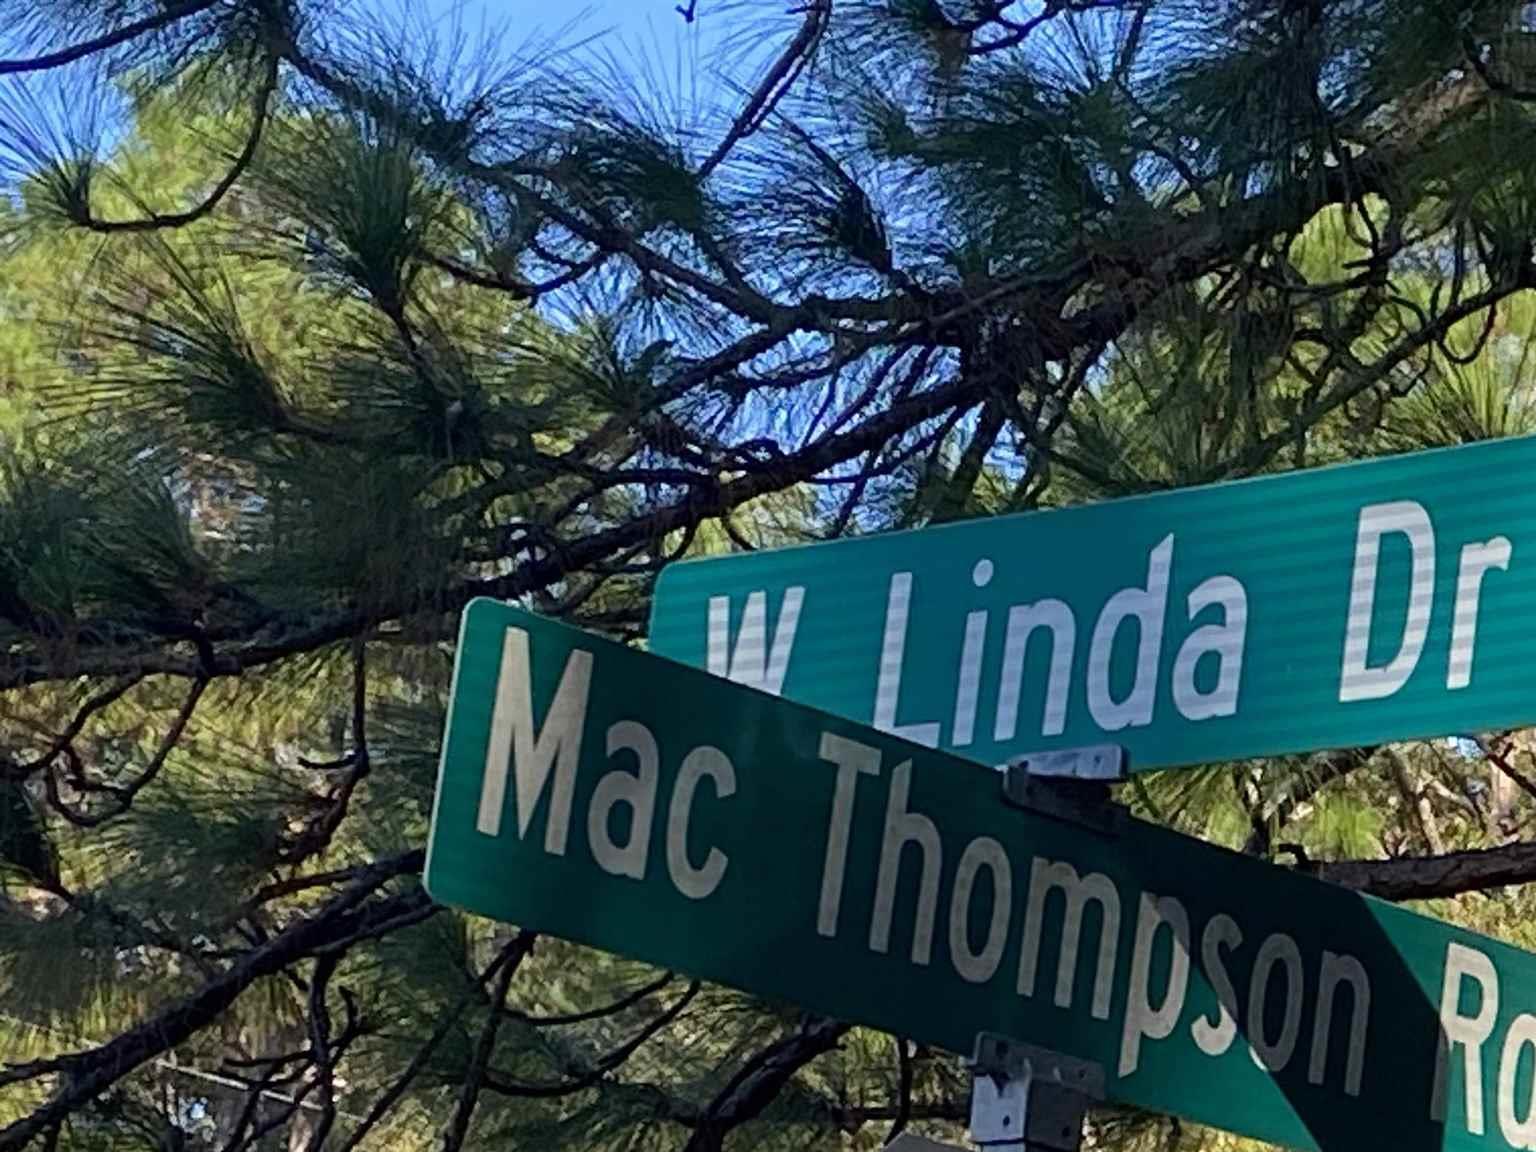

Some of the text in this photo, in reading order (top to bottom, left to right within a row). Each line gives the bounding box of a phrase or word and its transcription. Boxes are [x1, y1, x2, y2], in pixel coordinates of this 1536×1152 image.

[706, 499, 1514, 749] W Linda Dr
[475, 626, 738, 901] Mac
[815, 730, 1371, 1097] Thompson
